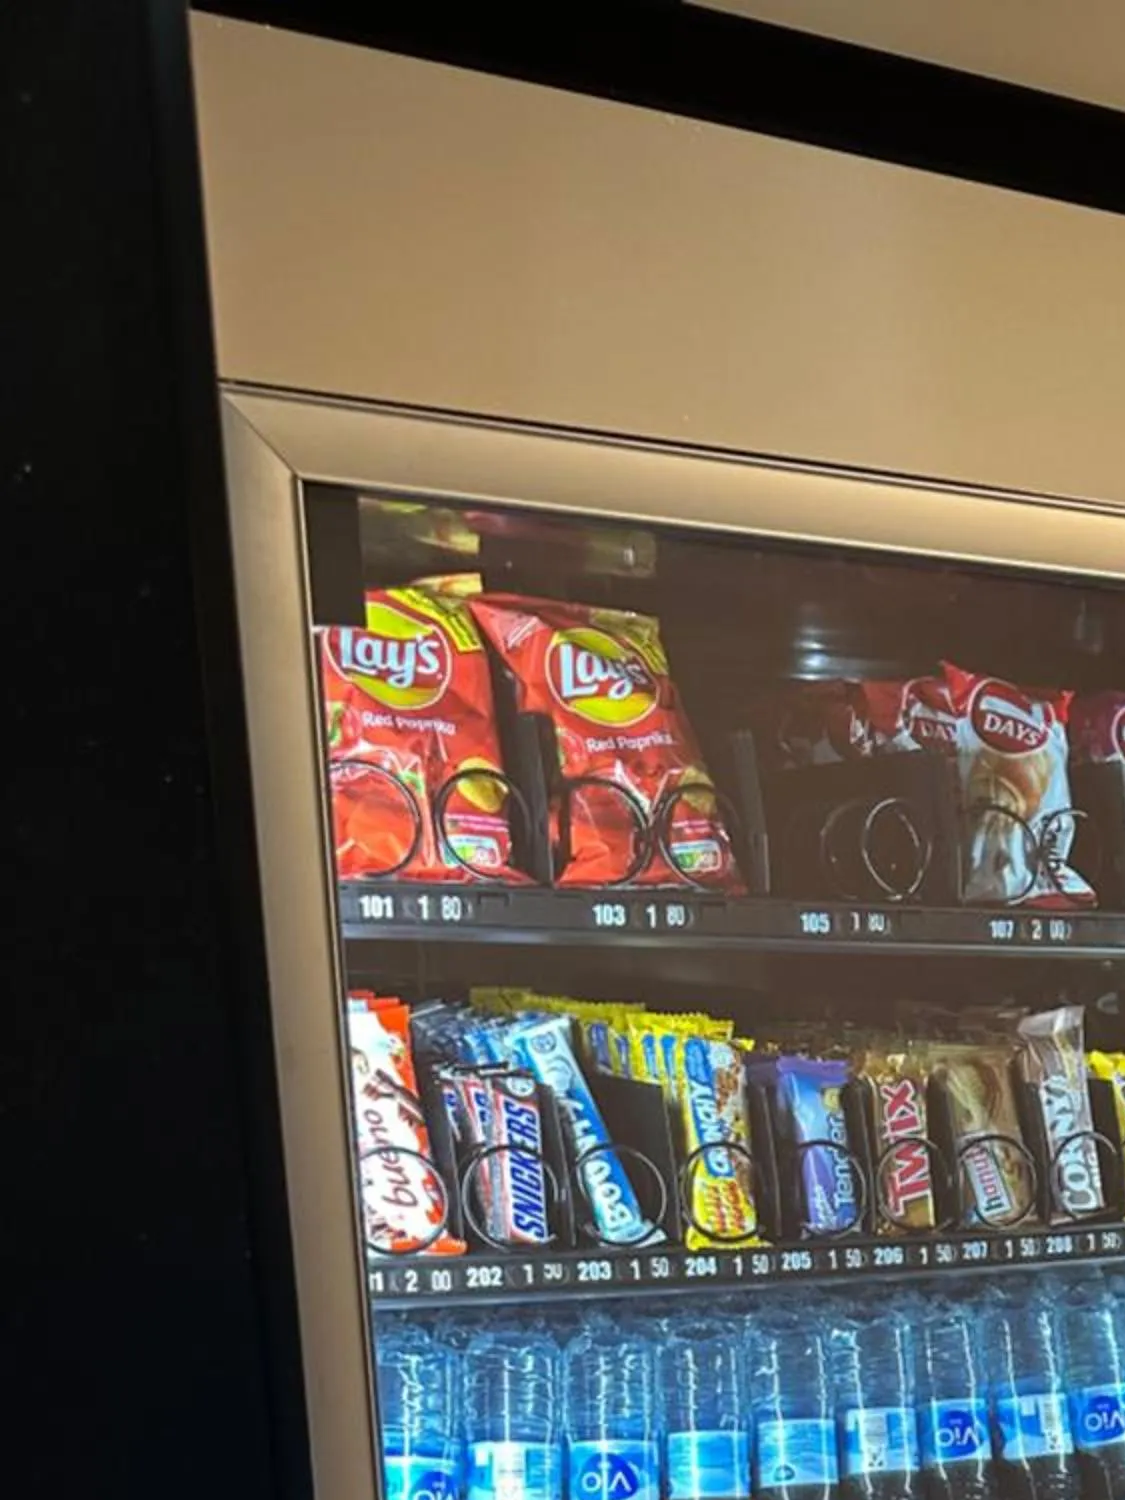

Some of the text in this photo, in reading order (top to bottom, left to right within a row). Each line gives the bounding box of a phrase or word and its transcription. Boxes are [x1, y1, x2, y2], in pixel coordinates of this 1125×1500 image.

[340, 626, 440, 688] Lay's
[560, 642, 648, 700] Lay's
[983, 712, 1042, 746] DAYS
[359, 895, 462, 921] 101 1 80
[592, 903, 626, 927] 103
[645, 903, 657, 928] 1
[801, 912, 830, 933] 105
[989, 920, 1015, 939] 107
[1031, 919, 1043, 940] 2
[689, 1079, 732, 1175] CRNCHY
[364, 1108, 420, 1209] bueno
[504, 1101, 546, 1240] SNICKERS
[781, 1248, 862, 1271] 205 1 50
[873, 1247, 904, 1266] 206
[962, 1240, 989, 1259] 207
[466, 1266, 503, 1288] 202
[523, 1264, 534, 1284] 1
[577, 1257, 670, 1281] 203 1 50
[685, 1254, 769, 1277] 204 1 50
[404, 1271, 418, 1292] 2
